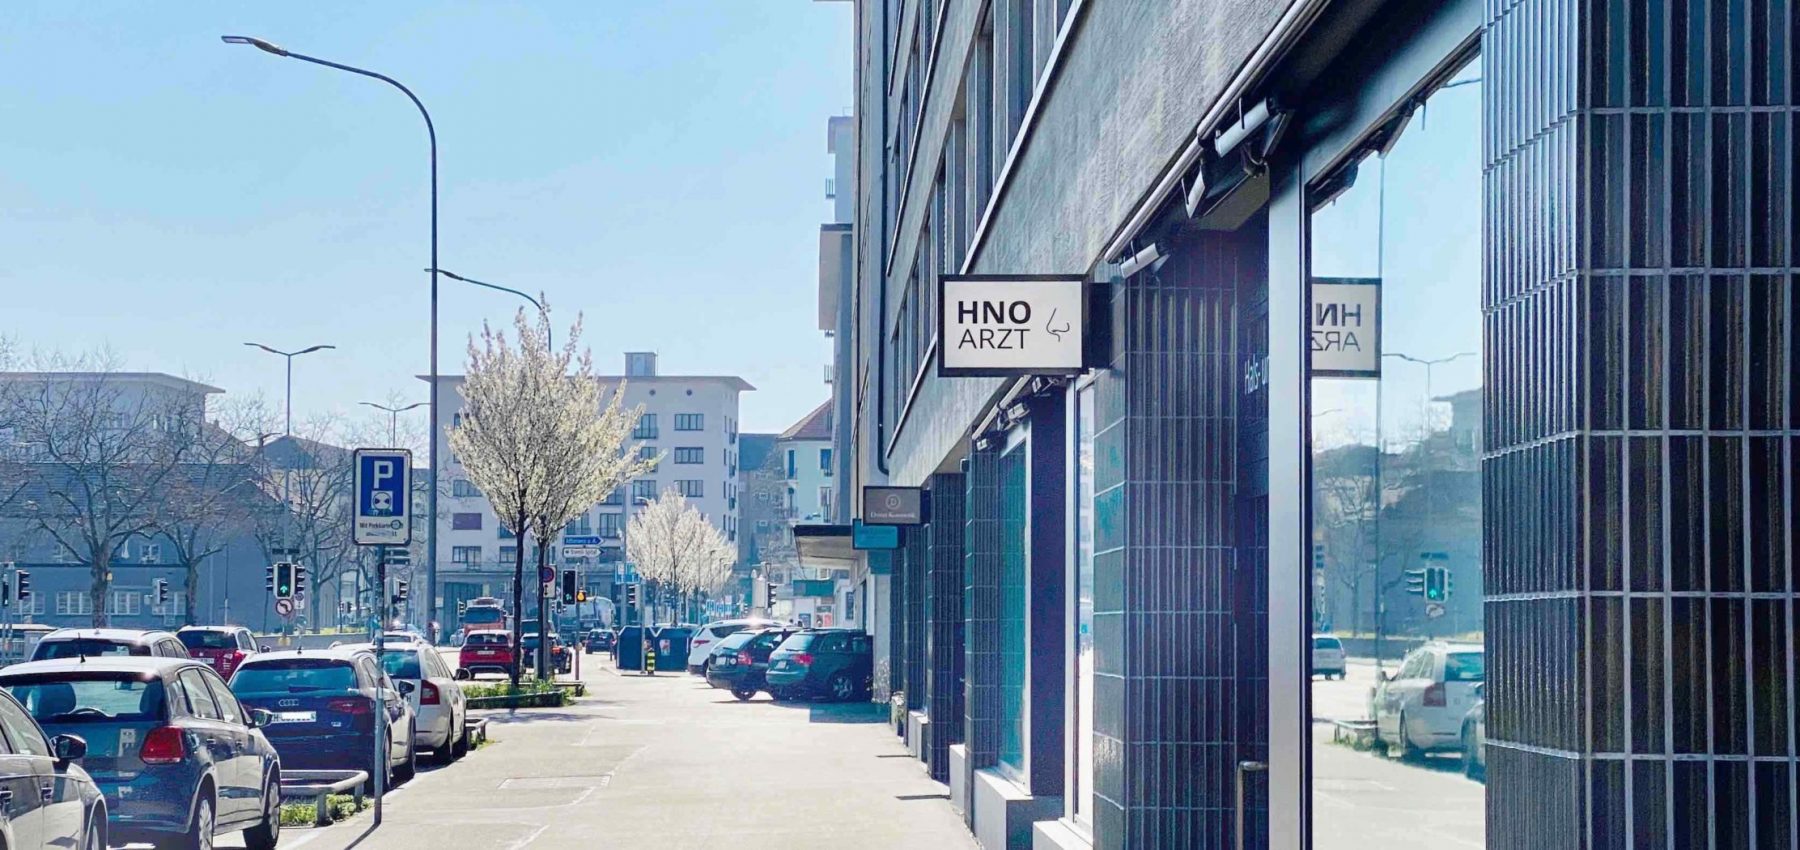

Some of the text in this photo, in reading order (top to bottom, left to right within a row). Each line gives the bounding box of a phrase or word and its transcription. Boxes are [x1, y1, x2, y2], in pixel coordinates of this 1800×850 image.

[958, 300, 1031, 324] HNO
[958, 328, 1030, 349] ARZT
[1244, 353, 1260, 395] Hals-
[374, 461, 393, 489] P
